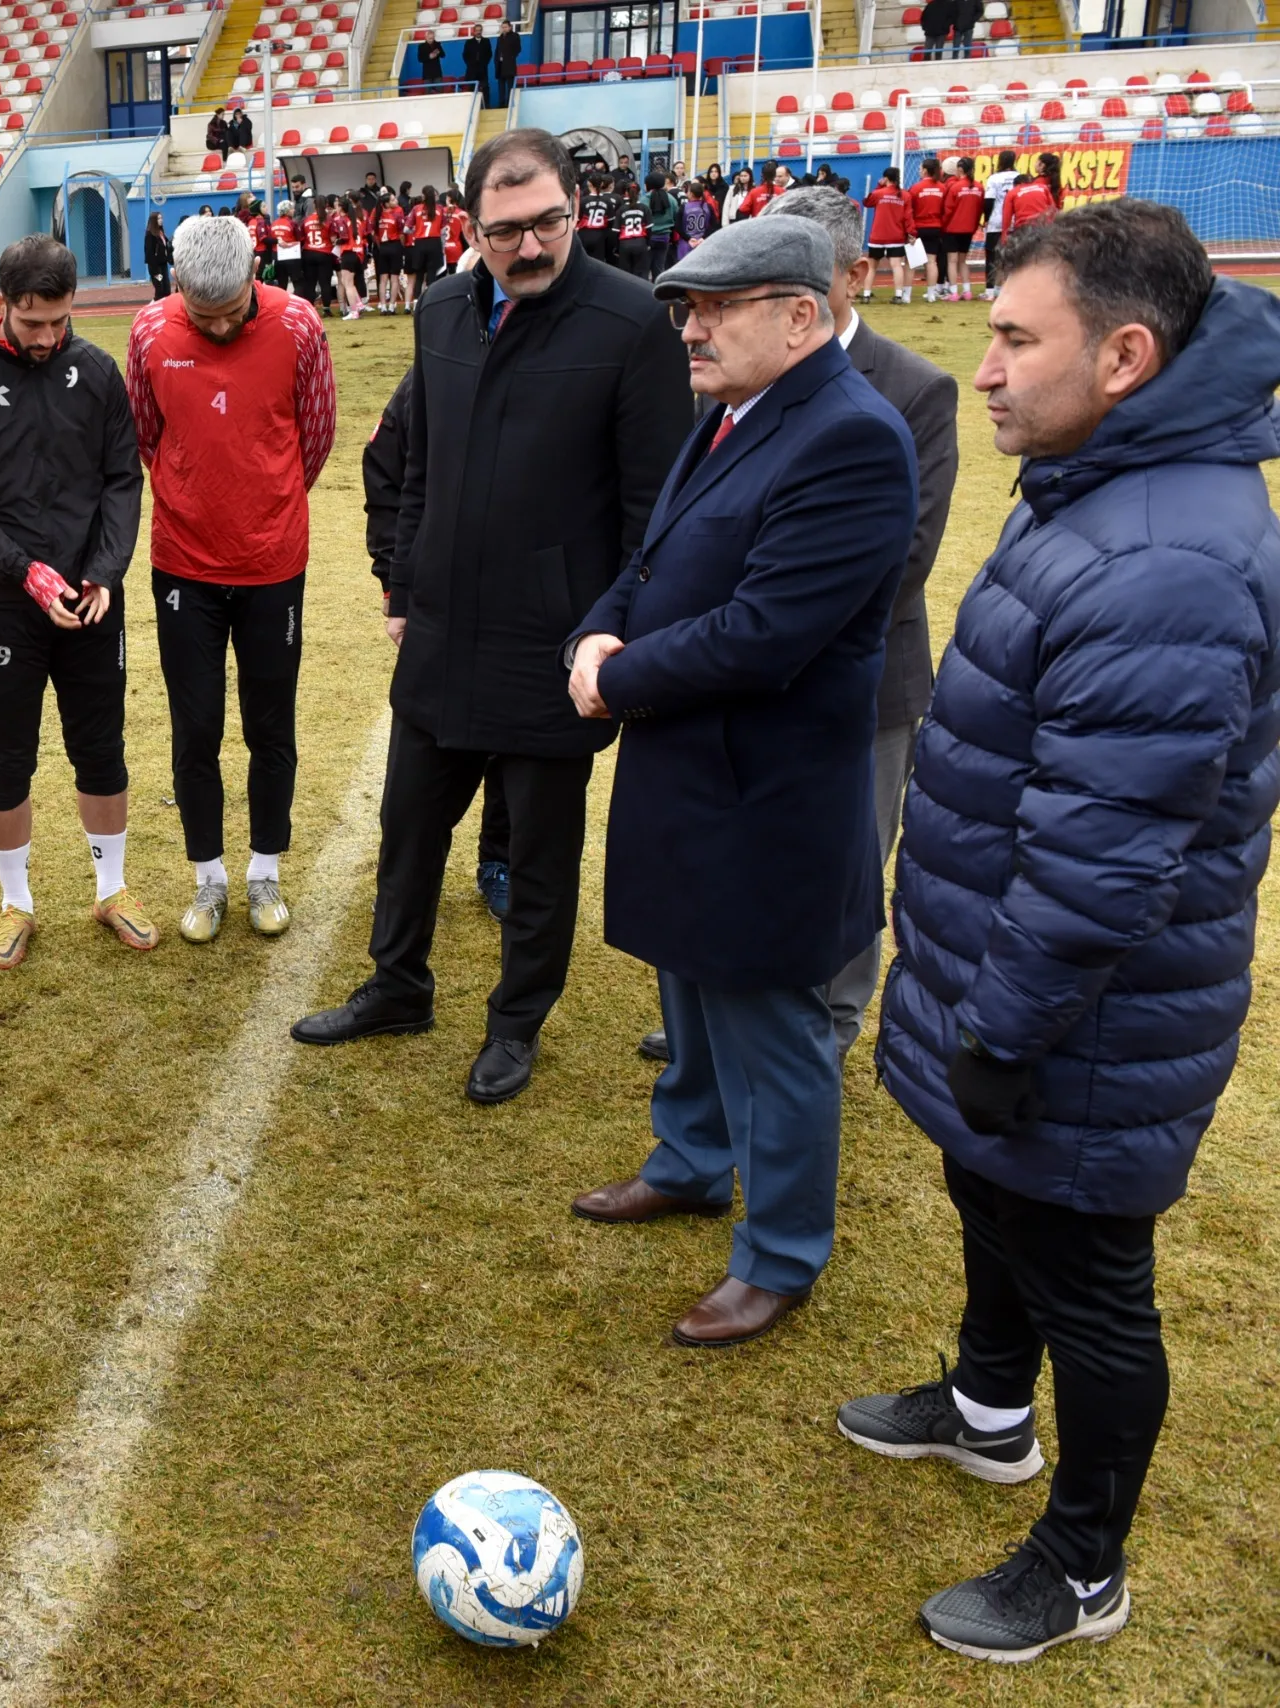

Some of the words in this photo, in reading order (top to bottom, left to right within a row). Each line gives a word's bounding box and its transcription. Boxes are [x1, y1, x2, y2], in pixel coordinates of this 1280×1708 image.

[423, 221, 432, 237] 7
[625, 217, 642, 236] 23
[687, 213, 706, 232] 30
[307, 231, 323, 245] 15
[162, 358, 194, 369] uhlsport
[210, 391, 226, 414] 4
[166, 589, 180, 610] 4
[286, 605, 295, 645] uhlsport
